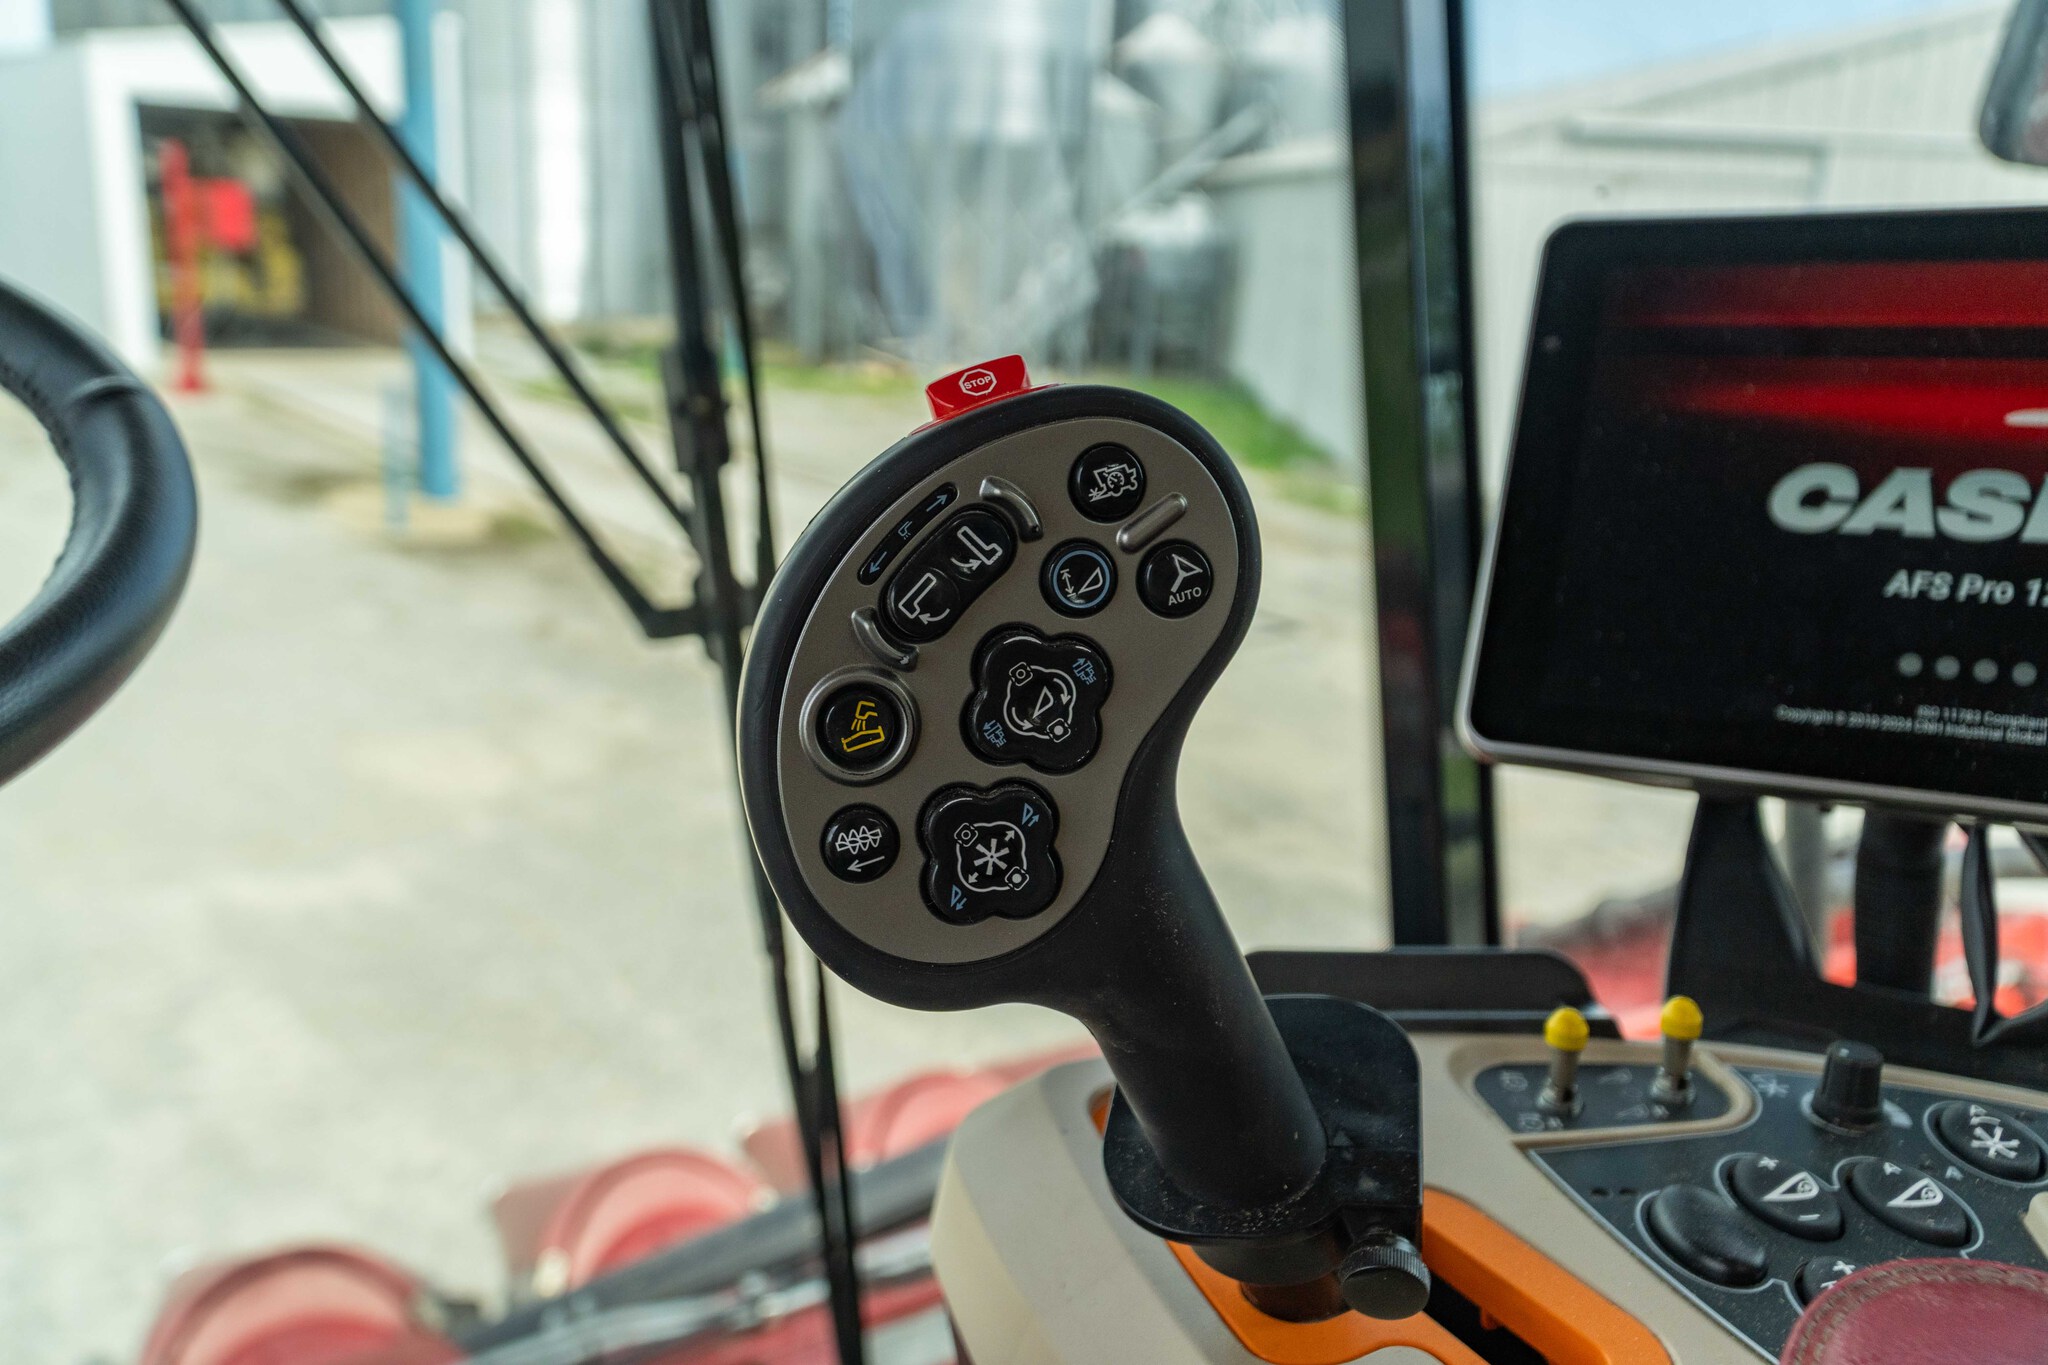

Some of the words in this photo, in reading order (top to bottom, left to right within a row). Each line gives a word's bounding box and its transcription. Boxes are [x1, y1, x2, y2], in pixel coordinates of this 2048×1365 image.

[963, 375, 992, 390] STOP
[1168, 586, 1202, 606] AUTO
[1883, 568, 1953, 601] AFS
[1956, 572, 2015, 605] Pro
